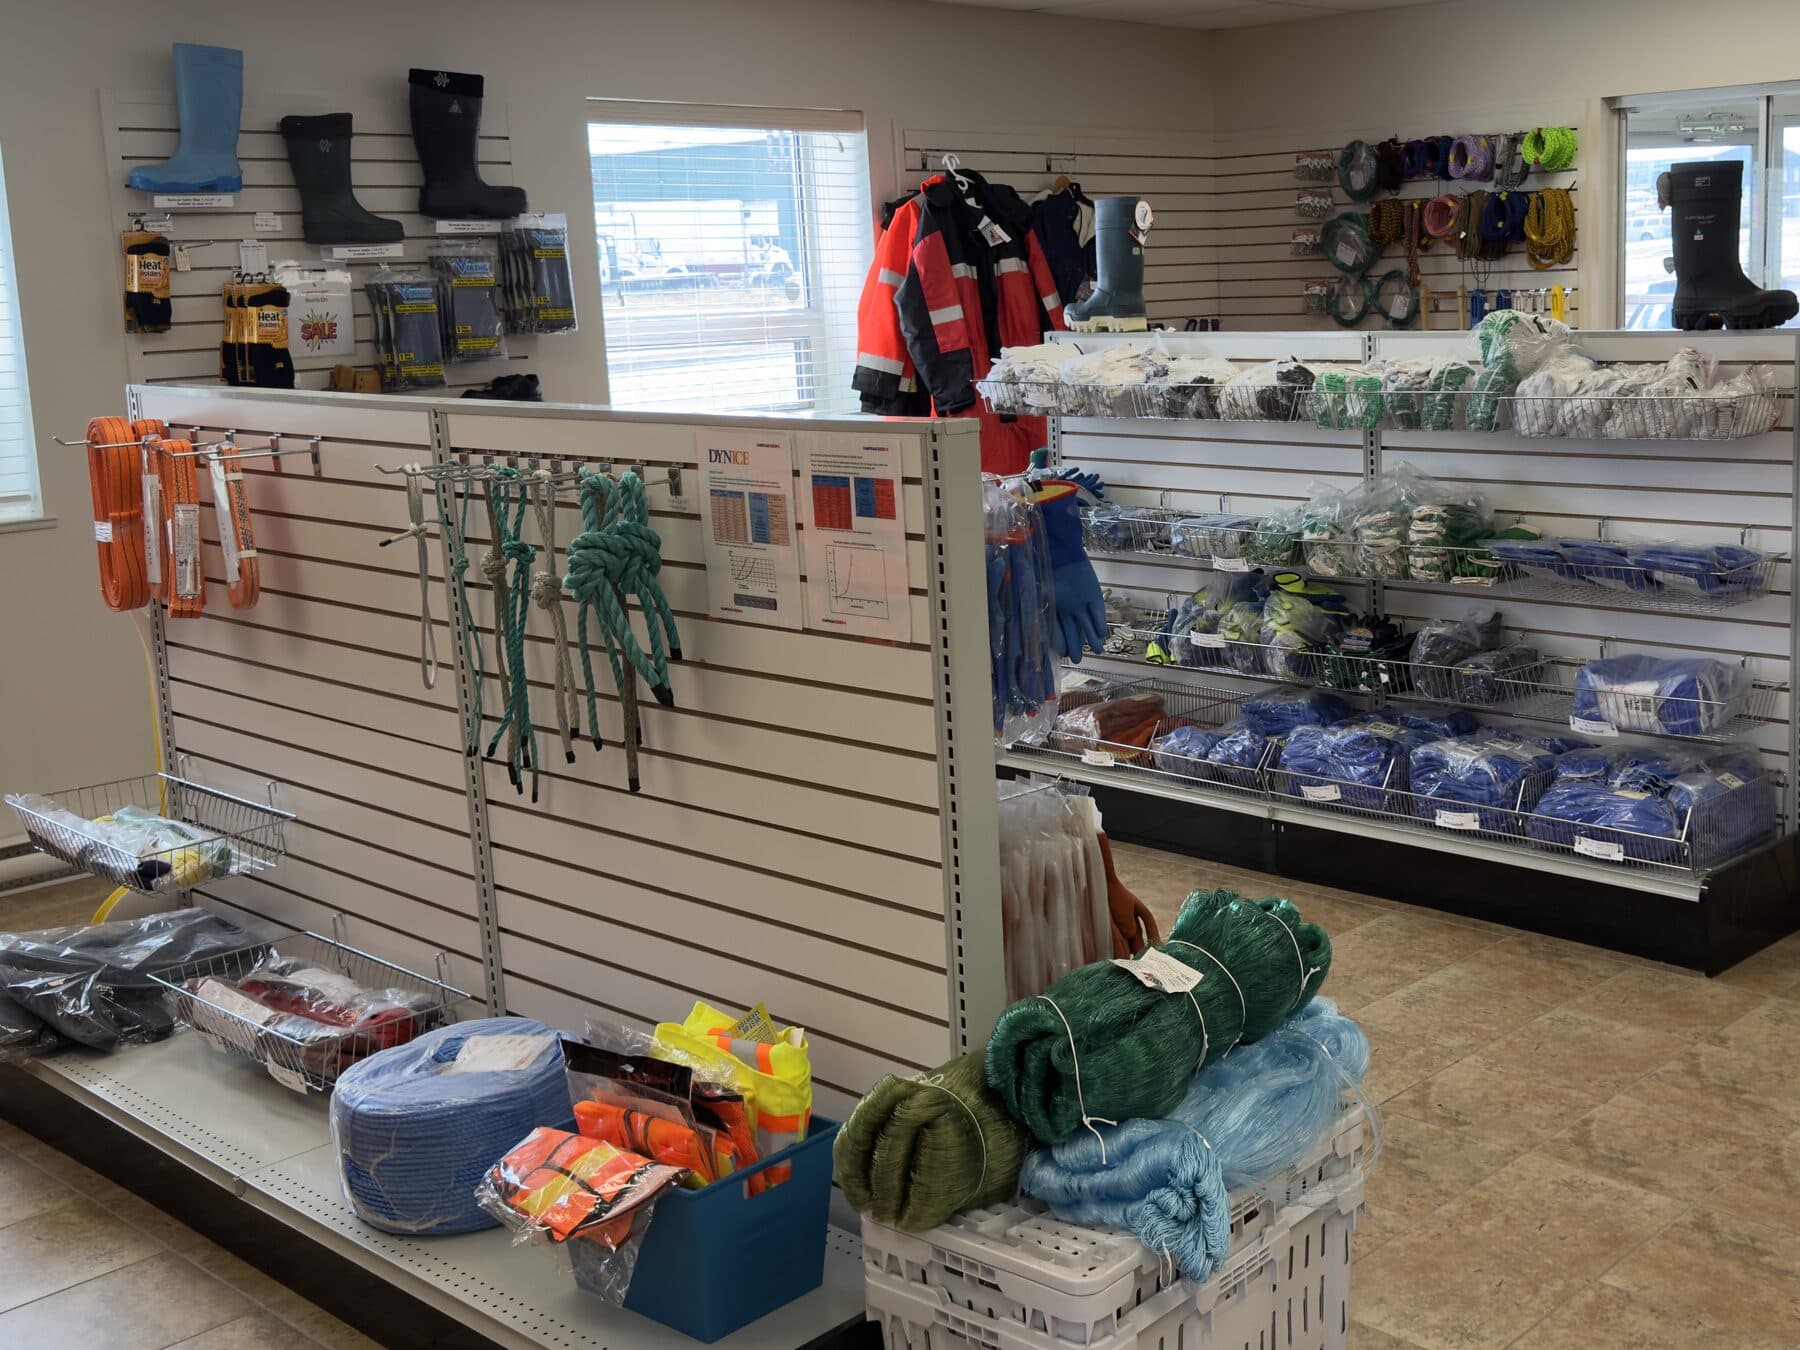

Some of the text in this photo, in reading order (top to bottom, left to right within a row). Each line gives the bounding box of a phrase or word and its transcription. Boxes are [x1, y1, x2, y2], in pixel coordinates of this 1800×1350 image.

[140, 260, 161, 270] Heat
[258, 311, 280, 321] Heat
[300, 321, 338, 341] SALE
[708, 449, 750, 465] DYNICE
